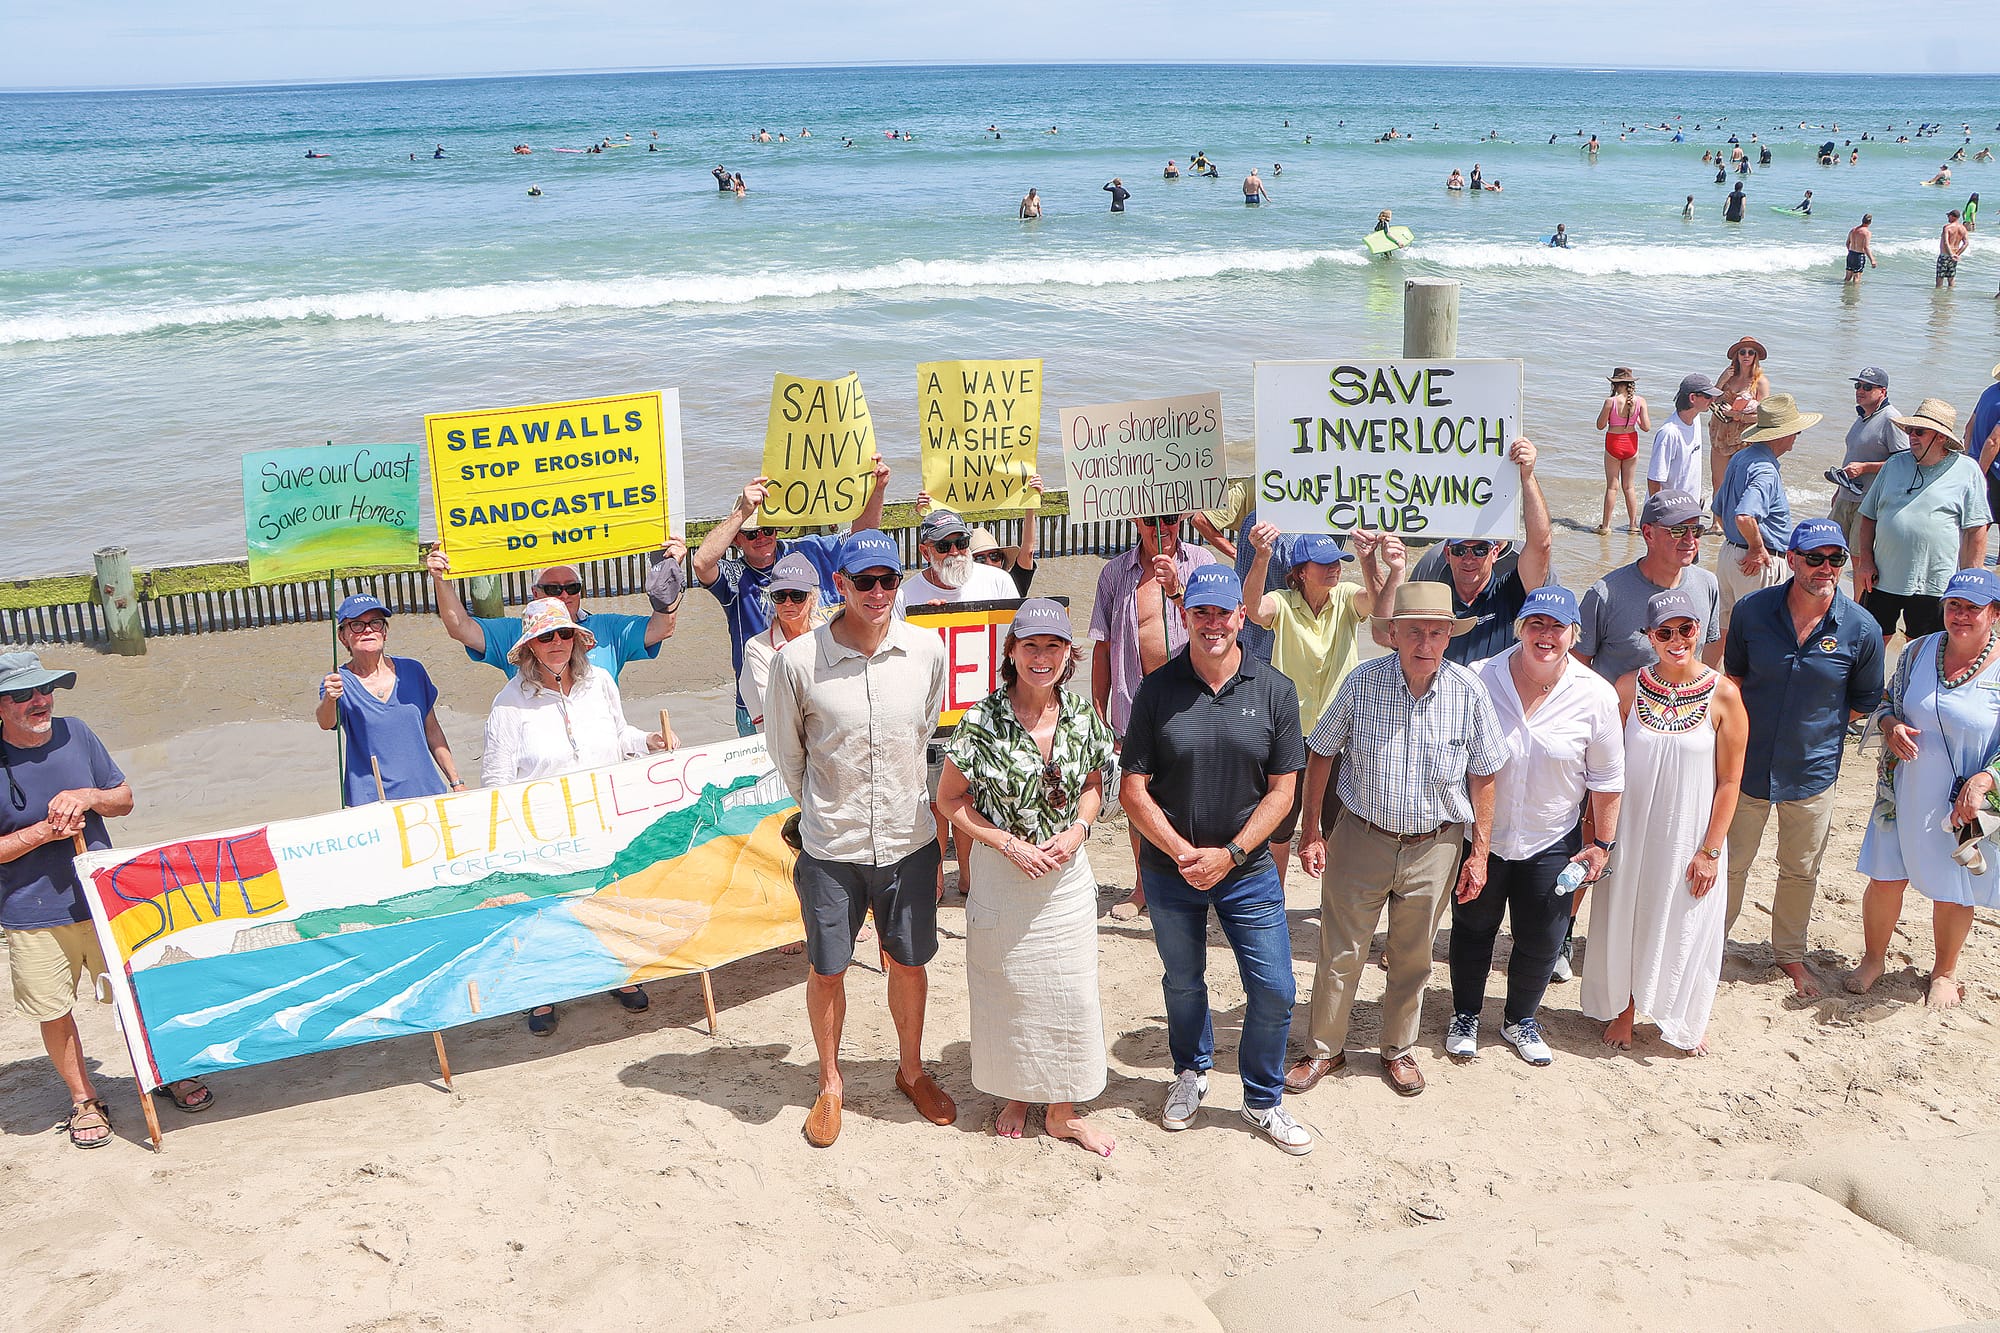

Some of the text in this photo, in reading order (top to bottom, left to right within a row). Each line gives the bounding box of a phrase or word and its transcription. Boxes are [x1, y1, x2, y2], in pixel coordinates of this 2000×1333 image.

[782, 378, 866, 423] SAVE
[927, 370, 1034, 394] A WAVE
[1329, 365, 1455, 407] SAVE
[447, 410, 643, 451] SEAWALLS
[927, 399, 1015, 423] A DAY
[1073, 405, 1217, 451] Our shoreline's
[785, 426, 868, 470] INVY
[928, 425, 1032, 451] WASHES
[1289, 416, 1505, 457] INVERLOCH
[261, 449, 415, 493] Save our Coast
[461, 447, 639, 481] STOP EROSION,
[950, 452, 1013, 478] INVY
[1195, 448, 1214, 468] is
[449, 484, 657, 527] SANDCASTLES
[761, 470, 875, 516] COAST
[1261, 465, 1494, 508] SURF LIFE SAVING
[259, 495, 407, 540] Save our Homes
[1325, 503, 1429, 533] CLUB
[507, 533, 538, 551] DO
[112, 832, 285, 951] SAVE
[282, 828, 381, 861] INVERLOCH
[392, 772, 613, 869] BEACH,
[432, 837, 591, 880] FORESHORE
